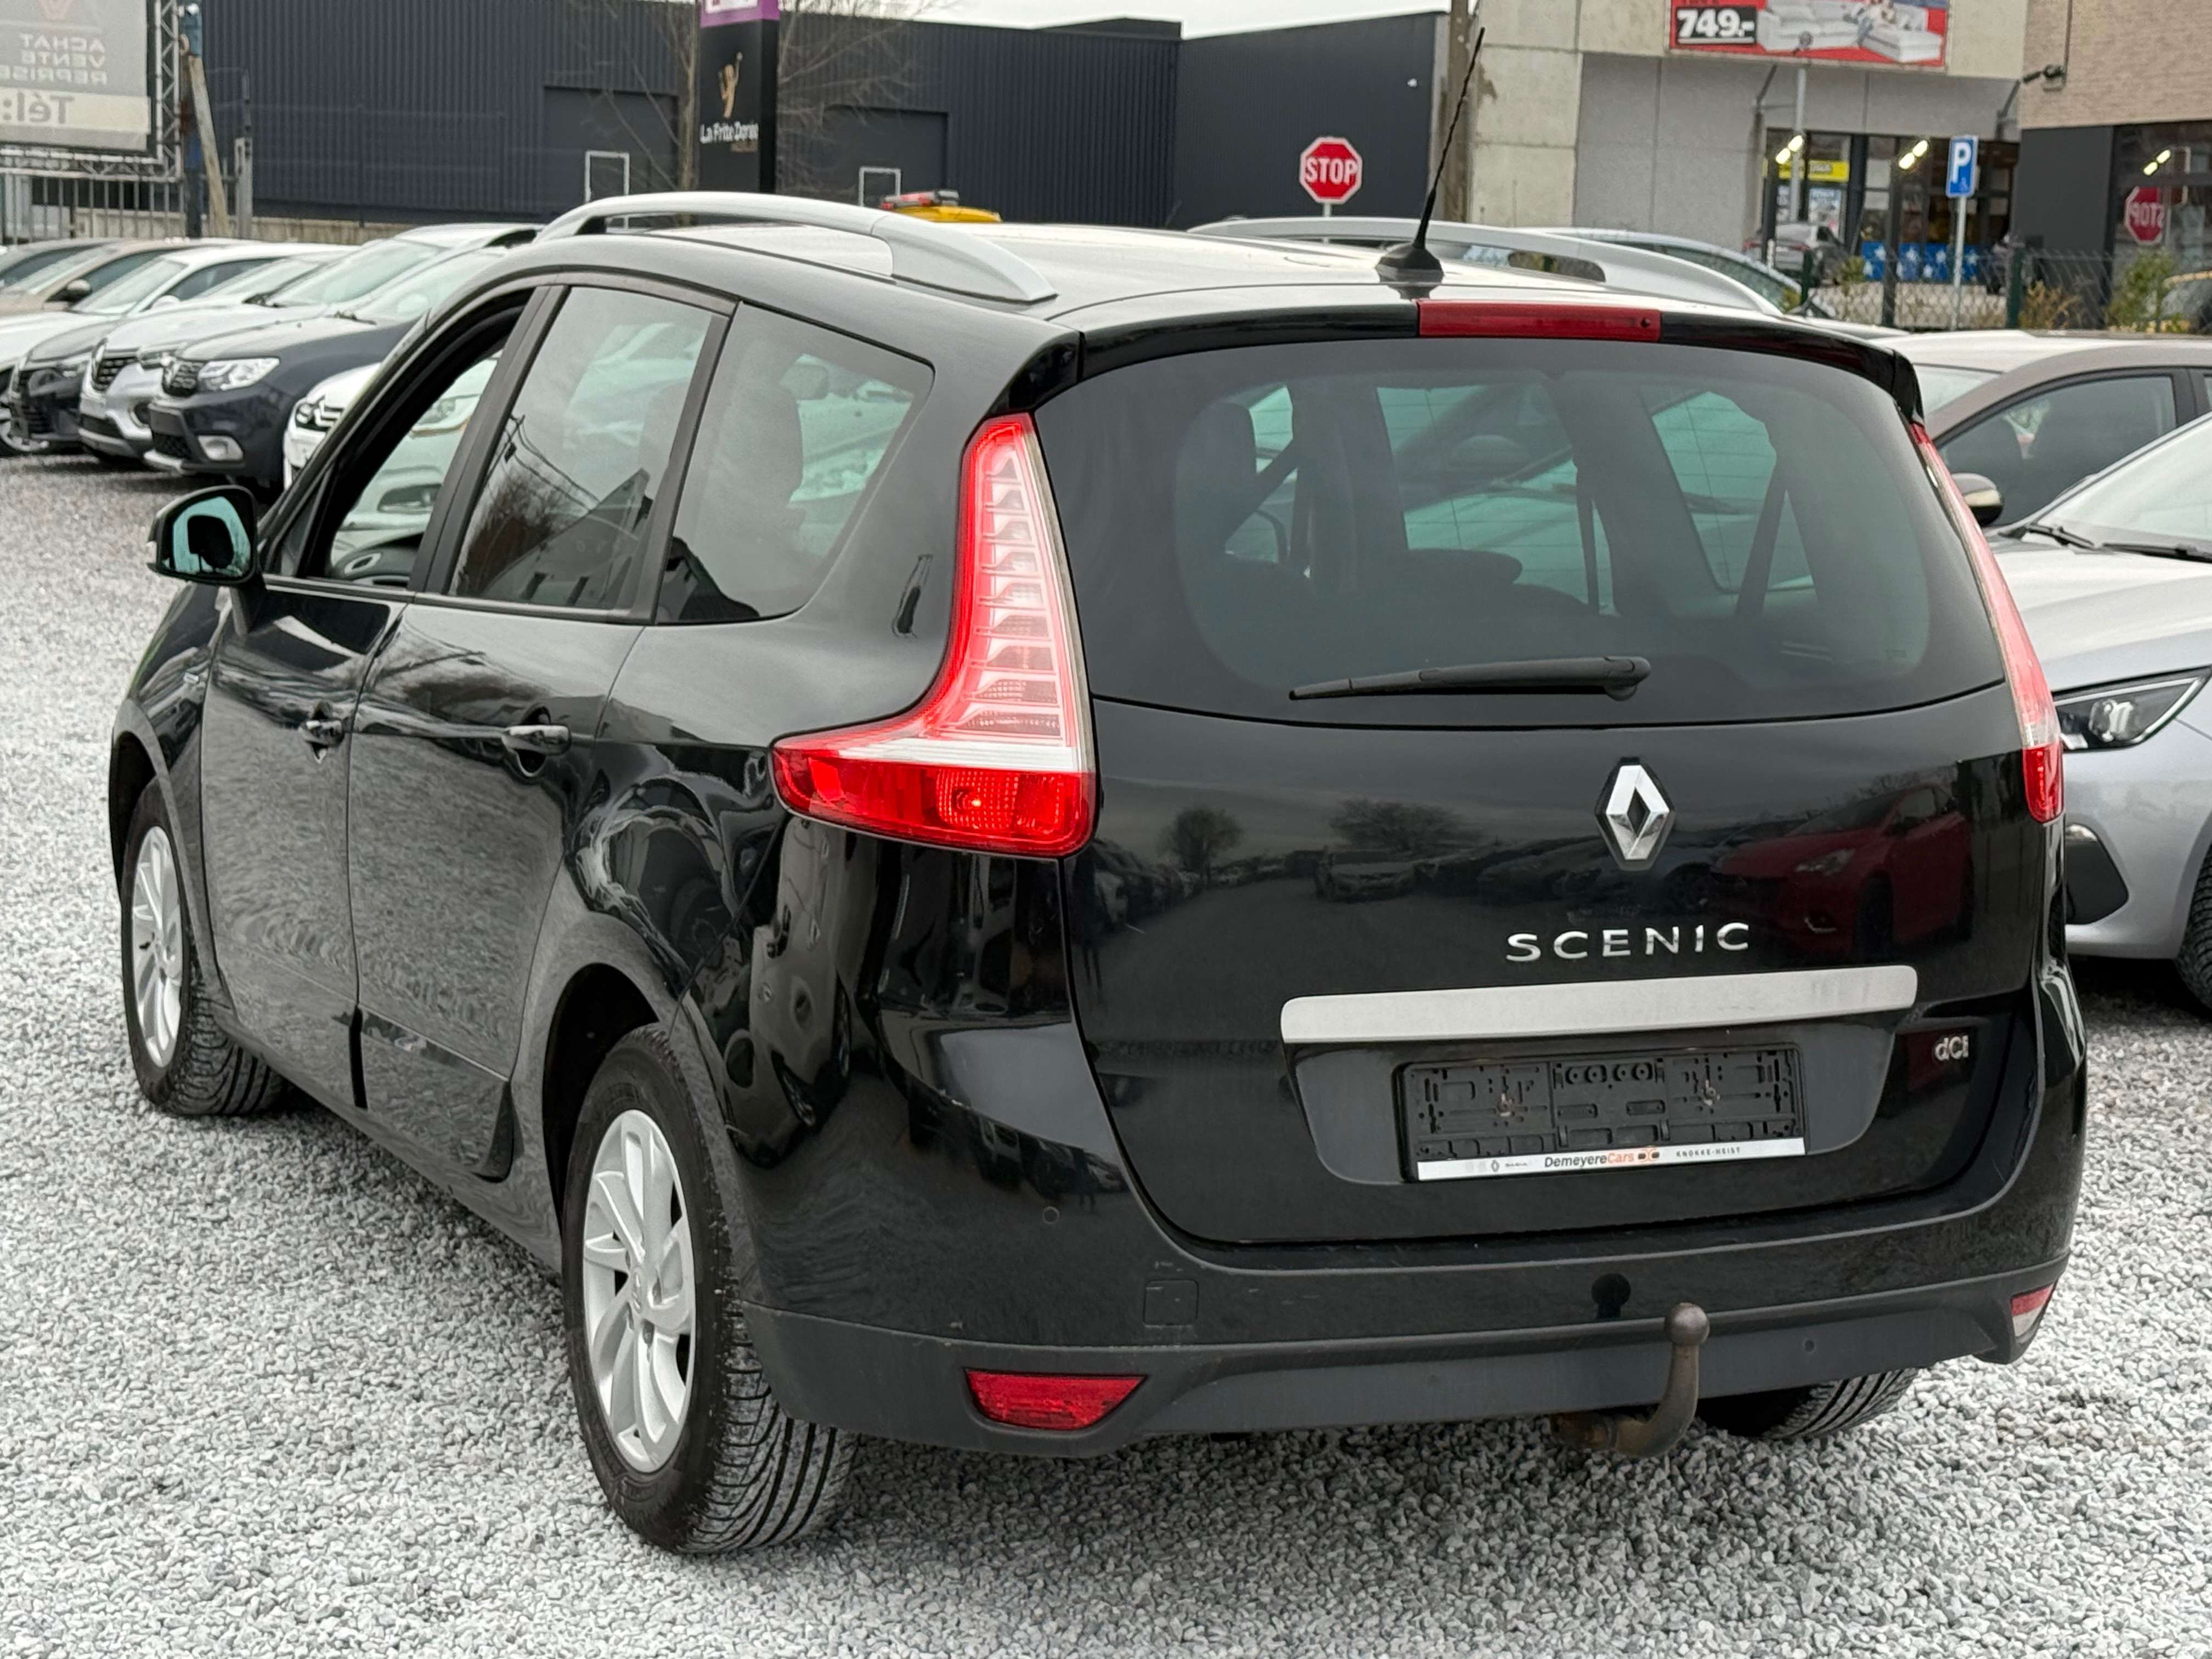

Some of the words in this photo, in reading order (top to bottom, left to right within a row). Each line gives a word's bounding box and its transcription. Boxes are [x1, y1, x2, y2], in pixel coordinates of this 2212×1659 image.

[1677, 8, 1755, 37] 749.-
[699, 124, 713, 144] La
[1306, 157, 1358, 184] STOP
[1953, 142, 1971, 184] P
[1506, 922, 1749, 962] SCENIC
[1544, 1153, 1634, 1169] DemeyereCars
[1676, 1147, 1741, 1157] KNOKKE-HEIST
